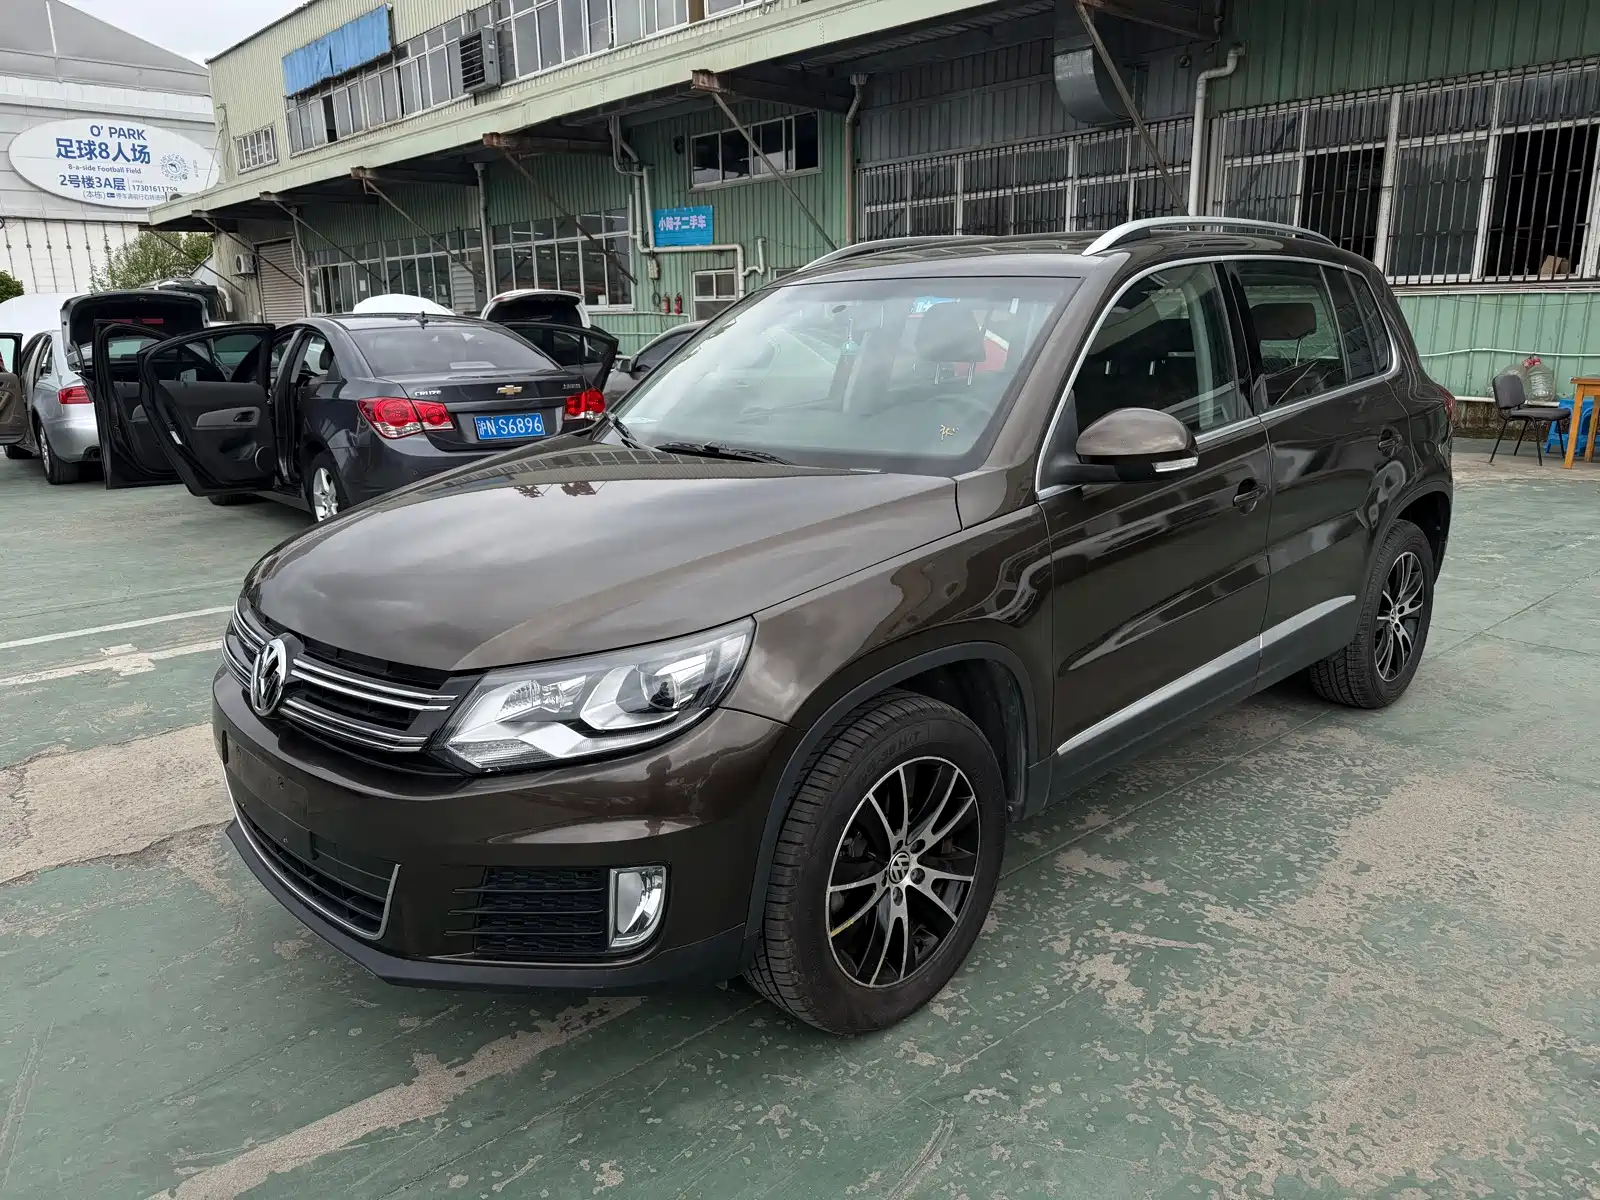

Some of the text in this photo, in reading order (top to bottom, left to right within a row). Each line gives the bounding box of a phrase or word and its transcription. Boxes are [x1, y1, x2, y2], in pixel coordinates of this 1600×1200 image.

[90, 125, 147, 141] O' PARK
[55, 137, 151, 164] 足球8人场
[68, 163, 142, 175] 8-a-side Football Field
[59, 174, 126, 191] 2号楼3A层
